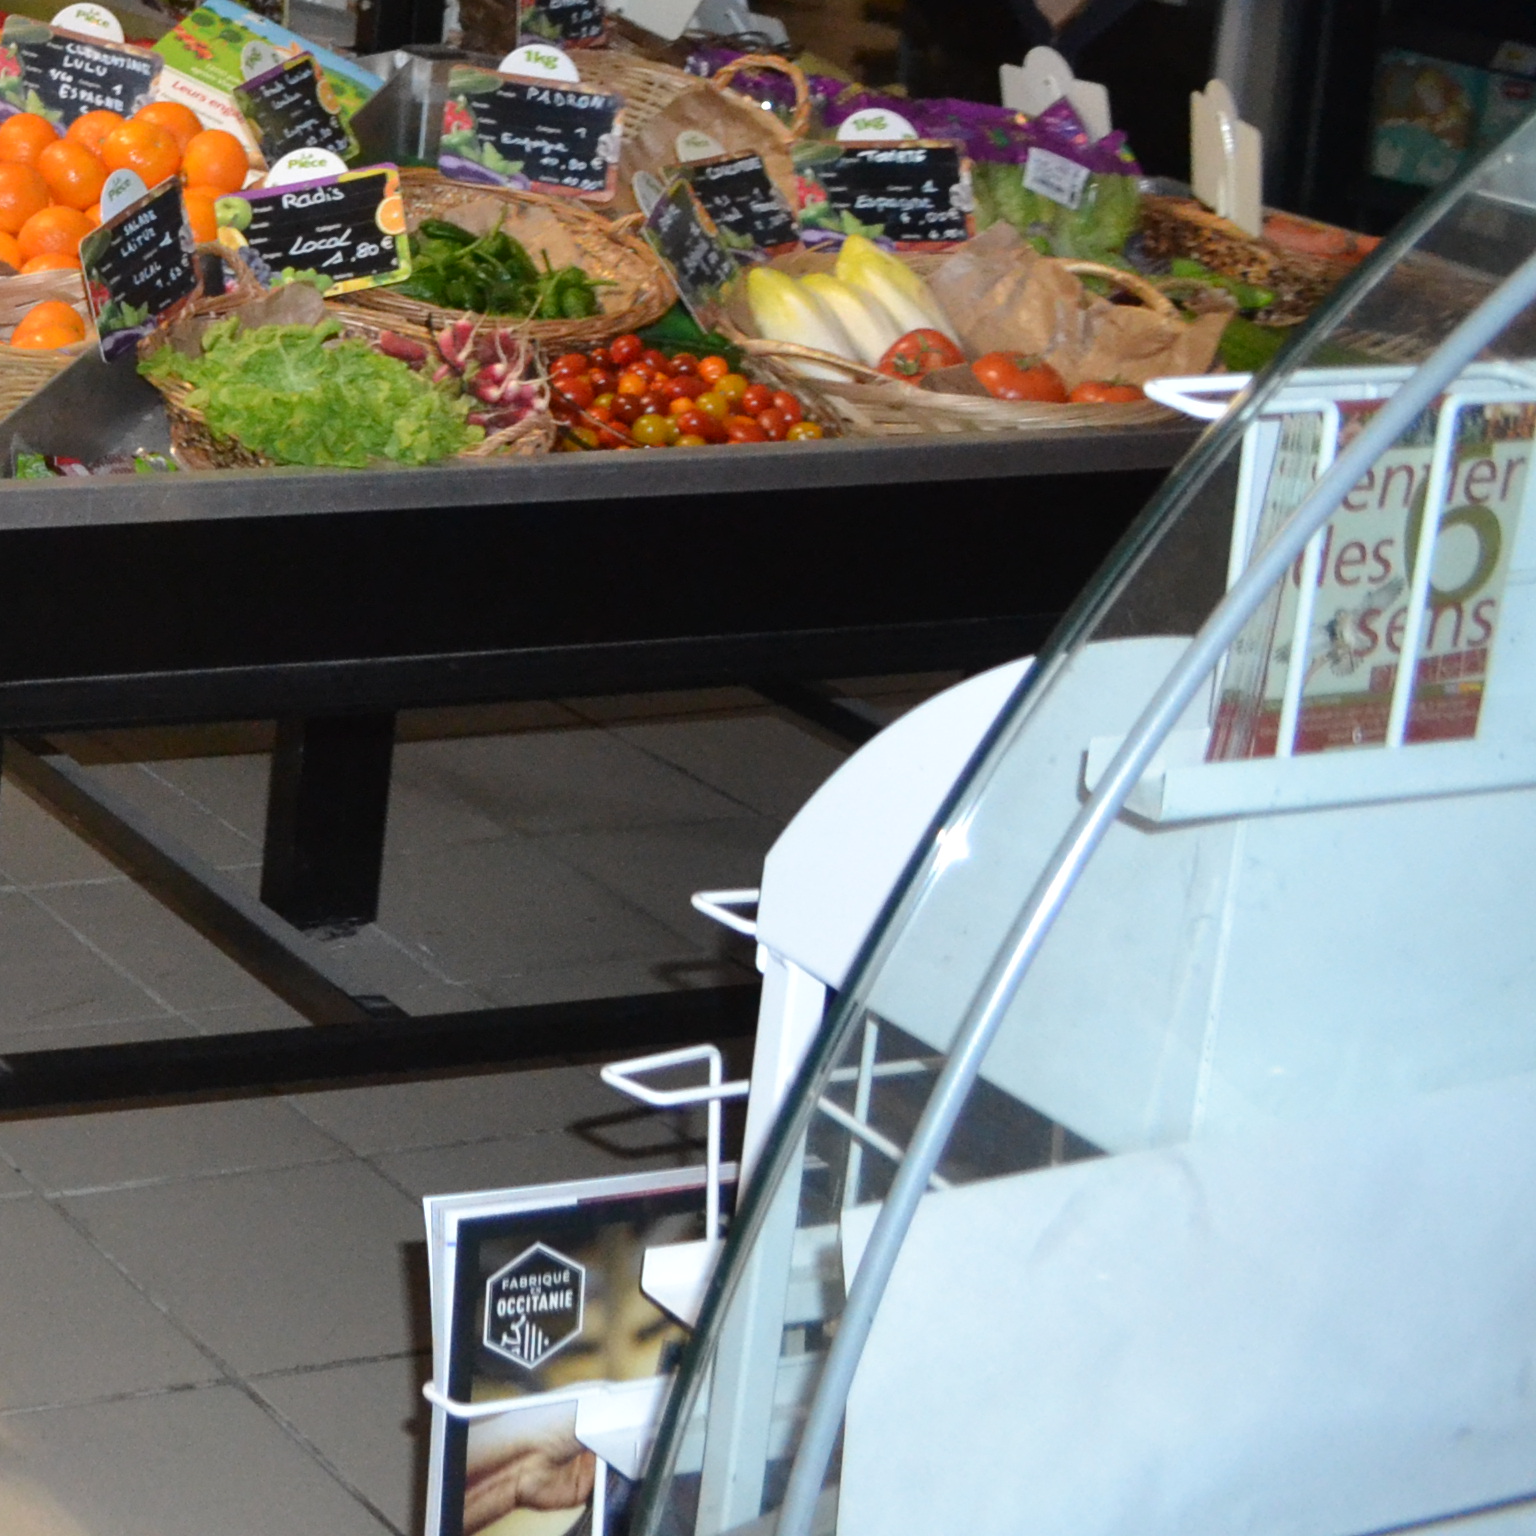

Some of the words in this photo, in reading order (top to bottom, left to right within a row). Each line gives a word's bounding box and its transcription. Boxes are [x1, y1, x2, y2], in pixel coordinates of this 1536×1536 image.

[62, 55, 108, 77] LULU
[524, 49, 559, 70] 1kg
[58, 82, 125, 113] ESPAGNE
[172, 79, 210, 104] Leurs
[281, 187, 345, 210] Radis
[1292, 524, 1395, 589] des
[1353, 597, 1497, 660] sens
[496, 1288, 574, 1318] OCCITANIE
